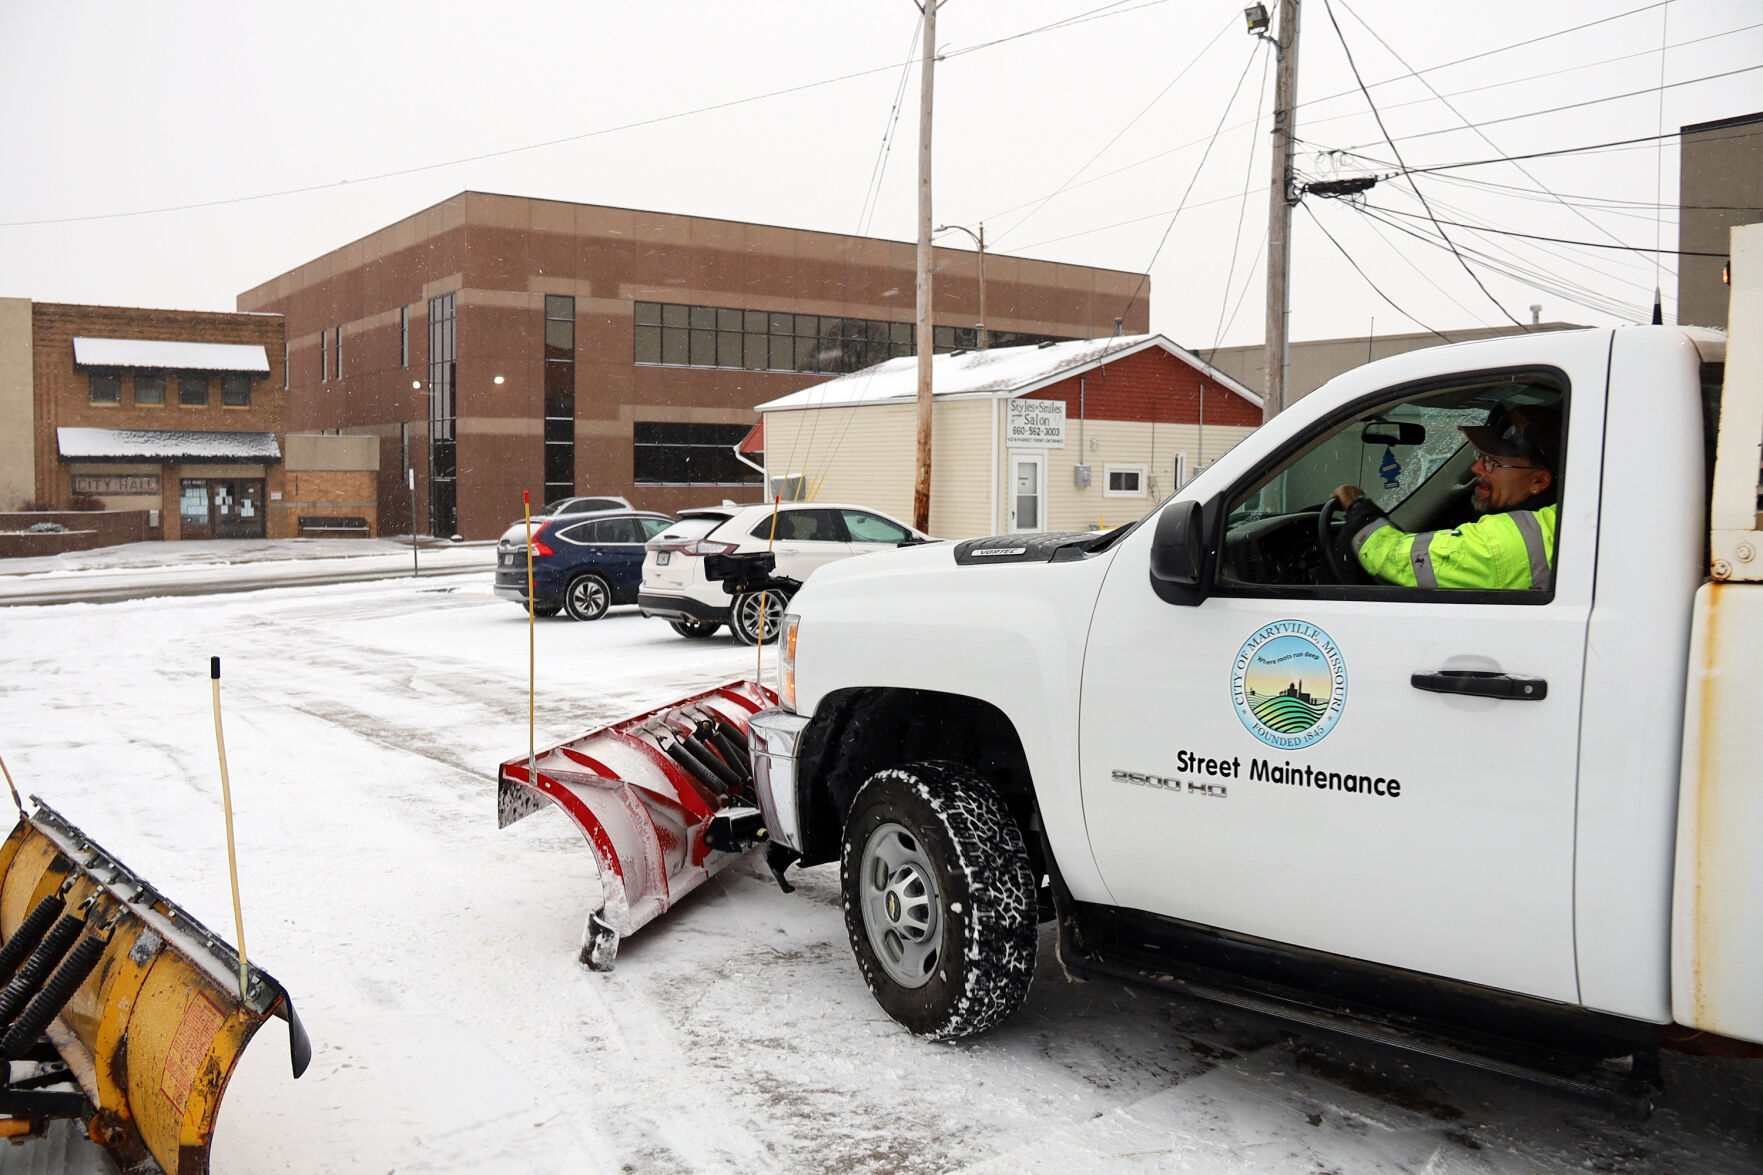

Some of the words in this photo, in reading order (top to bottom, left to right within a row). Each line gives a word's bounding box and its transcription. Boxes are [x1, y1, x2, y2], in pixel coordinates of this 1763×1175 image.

[1039, 401, 1063, 414] Smiles
[1024, 413, 1050, 426] Salon
[1012, 426, 1060, 437] 660-562-3003
[77, 479, 112, 491] CITY
[119, 478, 156, 491] HALL
[1247, 622, 1321, 651] MARYVILLE,
[1236, 650, 1249, 670] OF
[1257, 656, 1276, 665] Where
[1277, 654, 1292, 662] roots
[1304, 651, 1320, 660] deep
[1321, 640, 1345, 713] MISSOURI
[1233, 673, 1245, 706] CITY
[1252, 722, 1302, 747] FOUNDED
[1304, 725, 1325, 743] 1845
[1111, 768, 1182, 792] 2500
[1187, 781, 1227, 798] HD
[1176, 750, 1241, 779] Street
[1249, 758, 1401, 798] Maintenance
